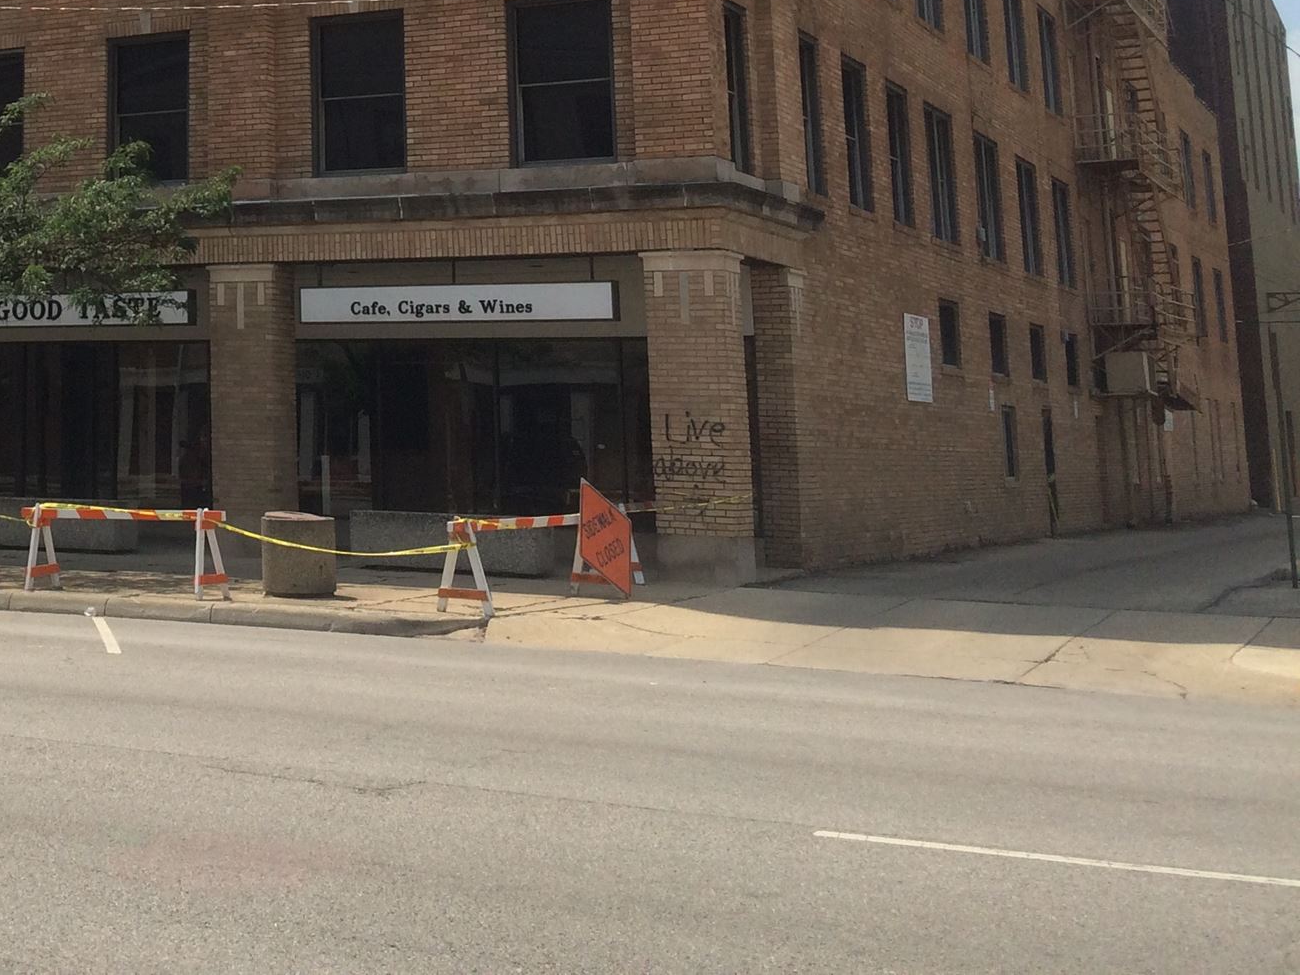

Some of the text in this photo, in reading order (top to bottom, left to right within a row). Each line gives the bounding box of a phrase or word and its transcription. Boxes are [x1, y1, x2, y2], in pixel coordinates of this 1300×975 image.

[350, 299, 533, 318] Cafe, Cigars & Wines
[665, 410, 725, 447] Live
[583, 506, 618, 540] SIDEWALK
[595, 538, 625, 568] CLOSED
